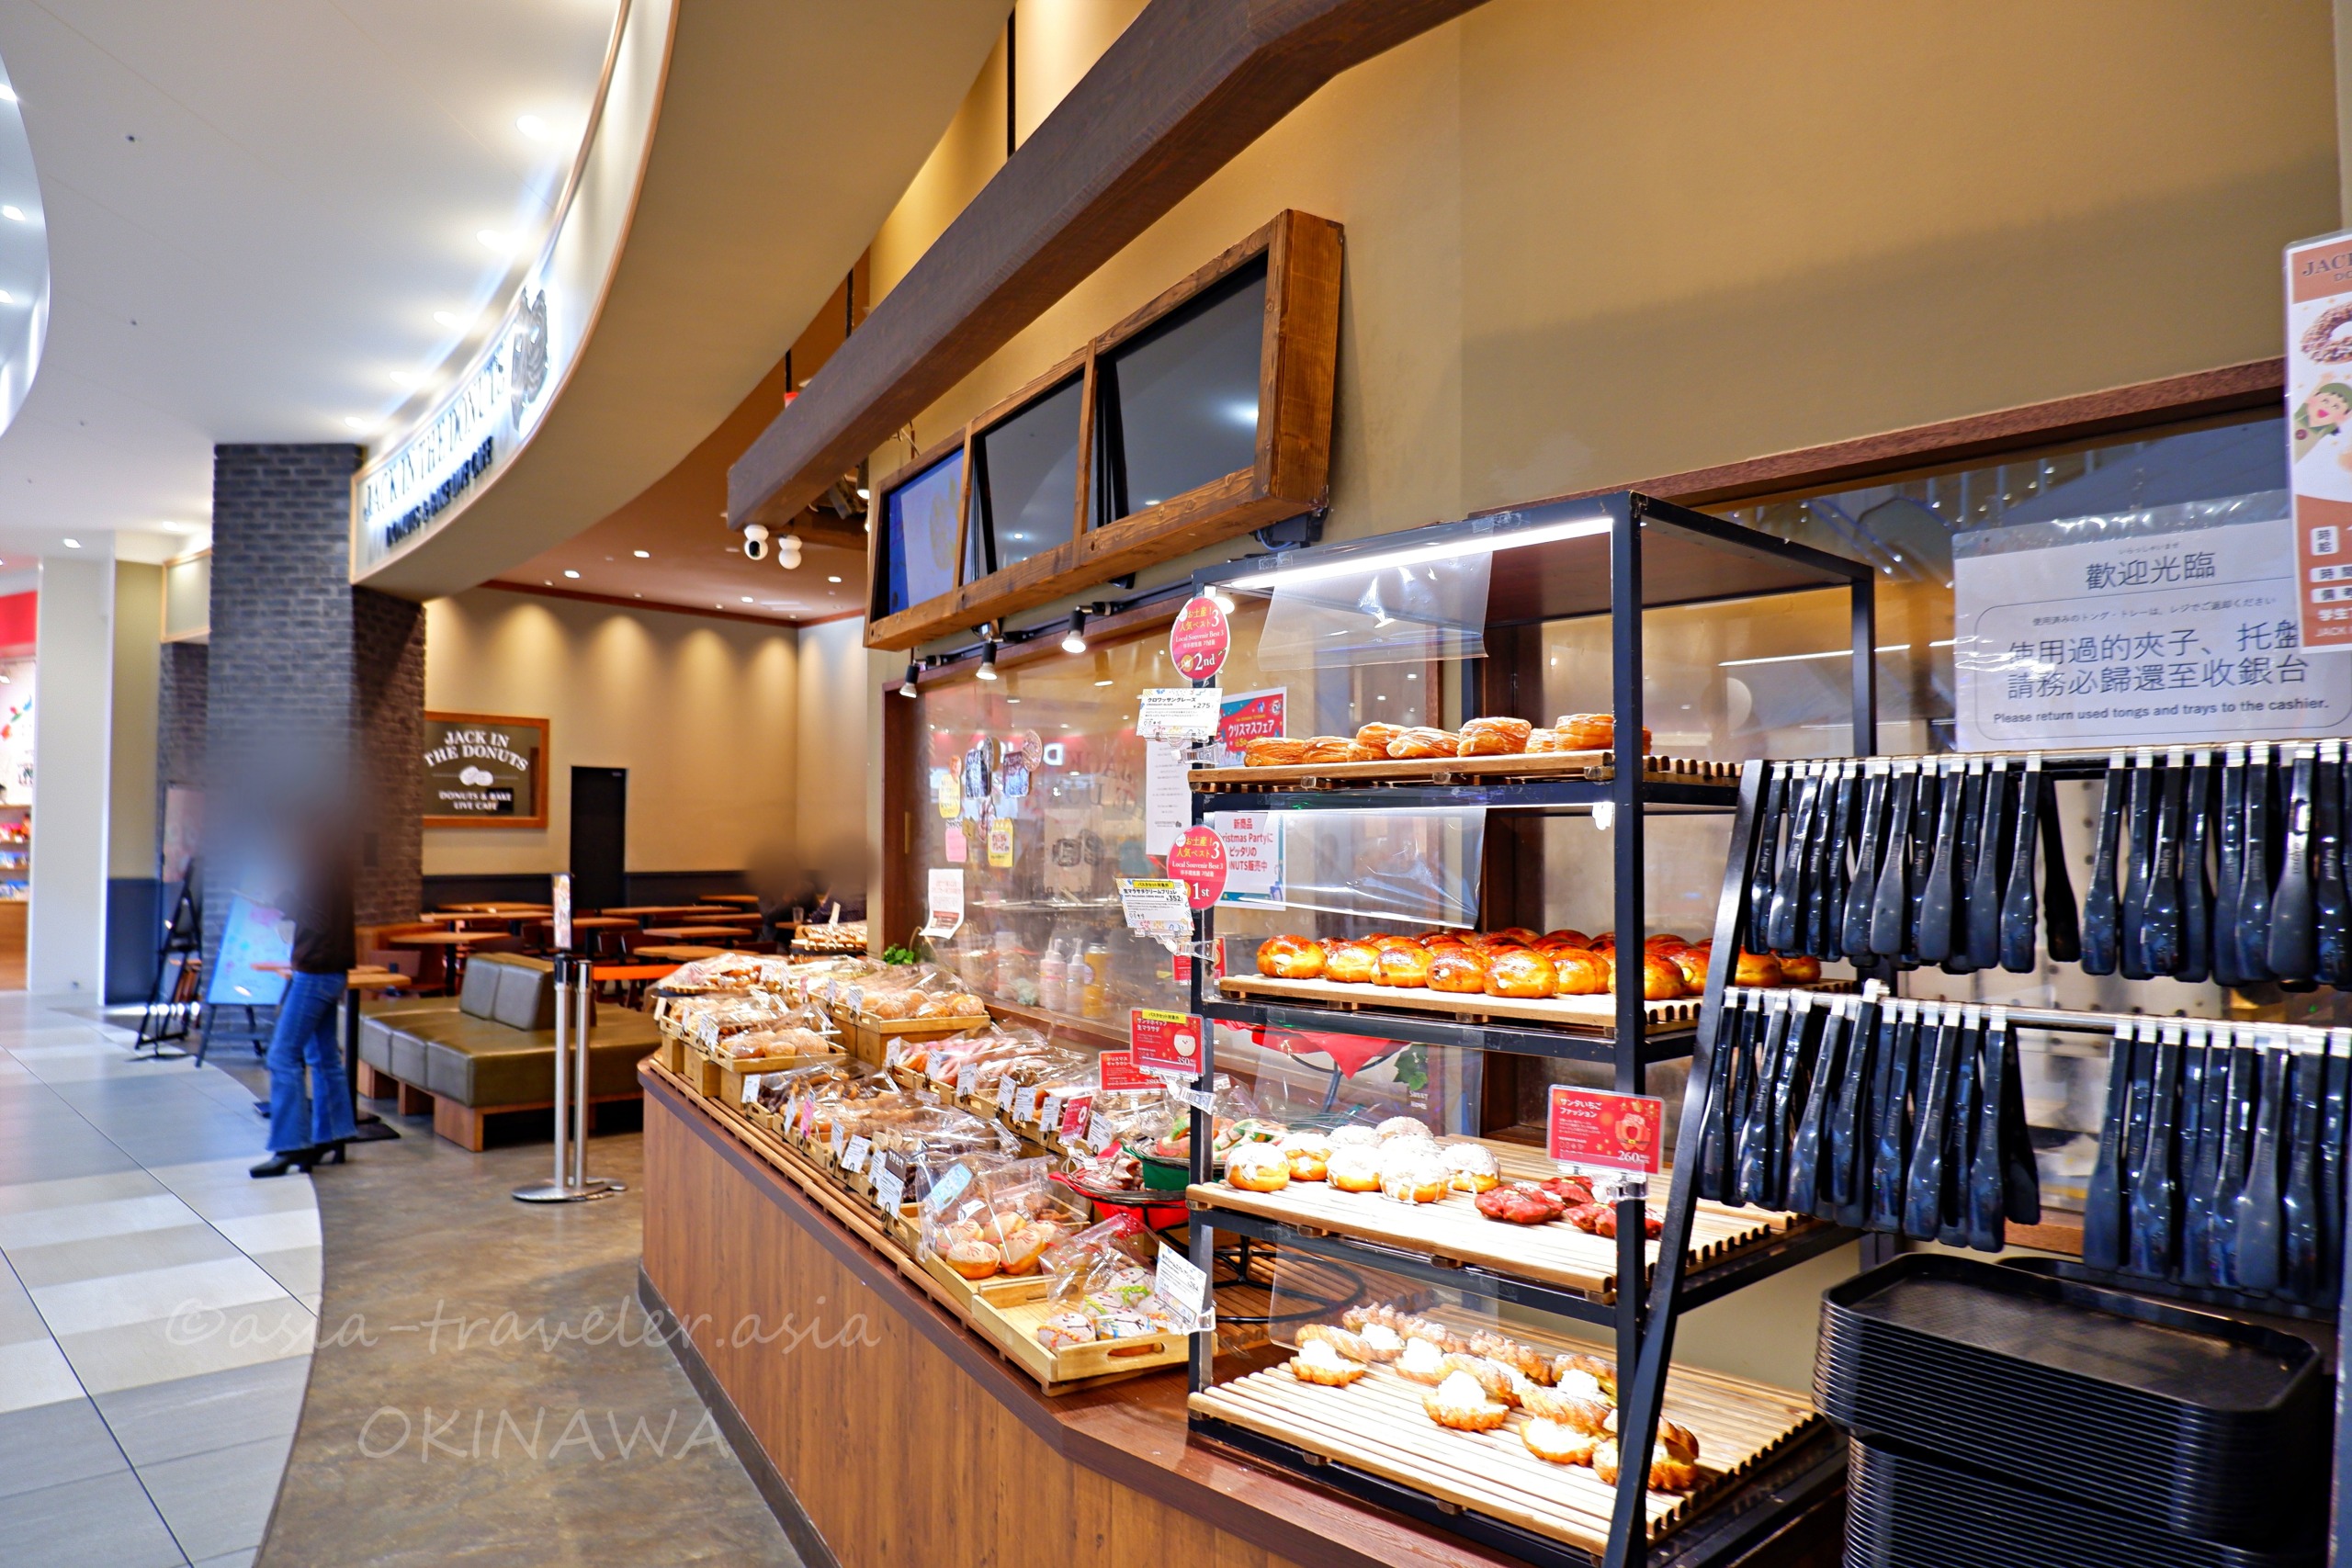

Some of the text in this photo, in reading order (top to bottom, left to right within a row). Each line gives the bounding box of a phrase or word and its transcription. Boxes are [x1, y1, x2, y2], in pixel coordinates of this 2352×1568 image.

[2086, 550, 2217, 591] 歡迎光臨
[1194, 652, 1216, 671] 2nd
[2007, 653, 2310, 699] 請務必歸還至收銀台
[1993, 697, 2329, 724] Please return used tongs and trays to the cashier.
[443, 729, 511, 749] JACK IN
[1227, 719, 1275, 739] クリスマスフェア
[424, 745, 529, 772] THE DONUTS
[1193, 882, 1210, 900] 1st
[1560, 1098, 1602, 1111] サンタいちご
[1560, 1107, 1597, 1118] ファッション
[1618, 1150, 1640, 1163] 260
